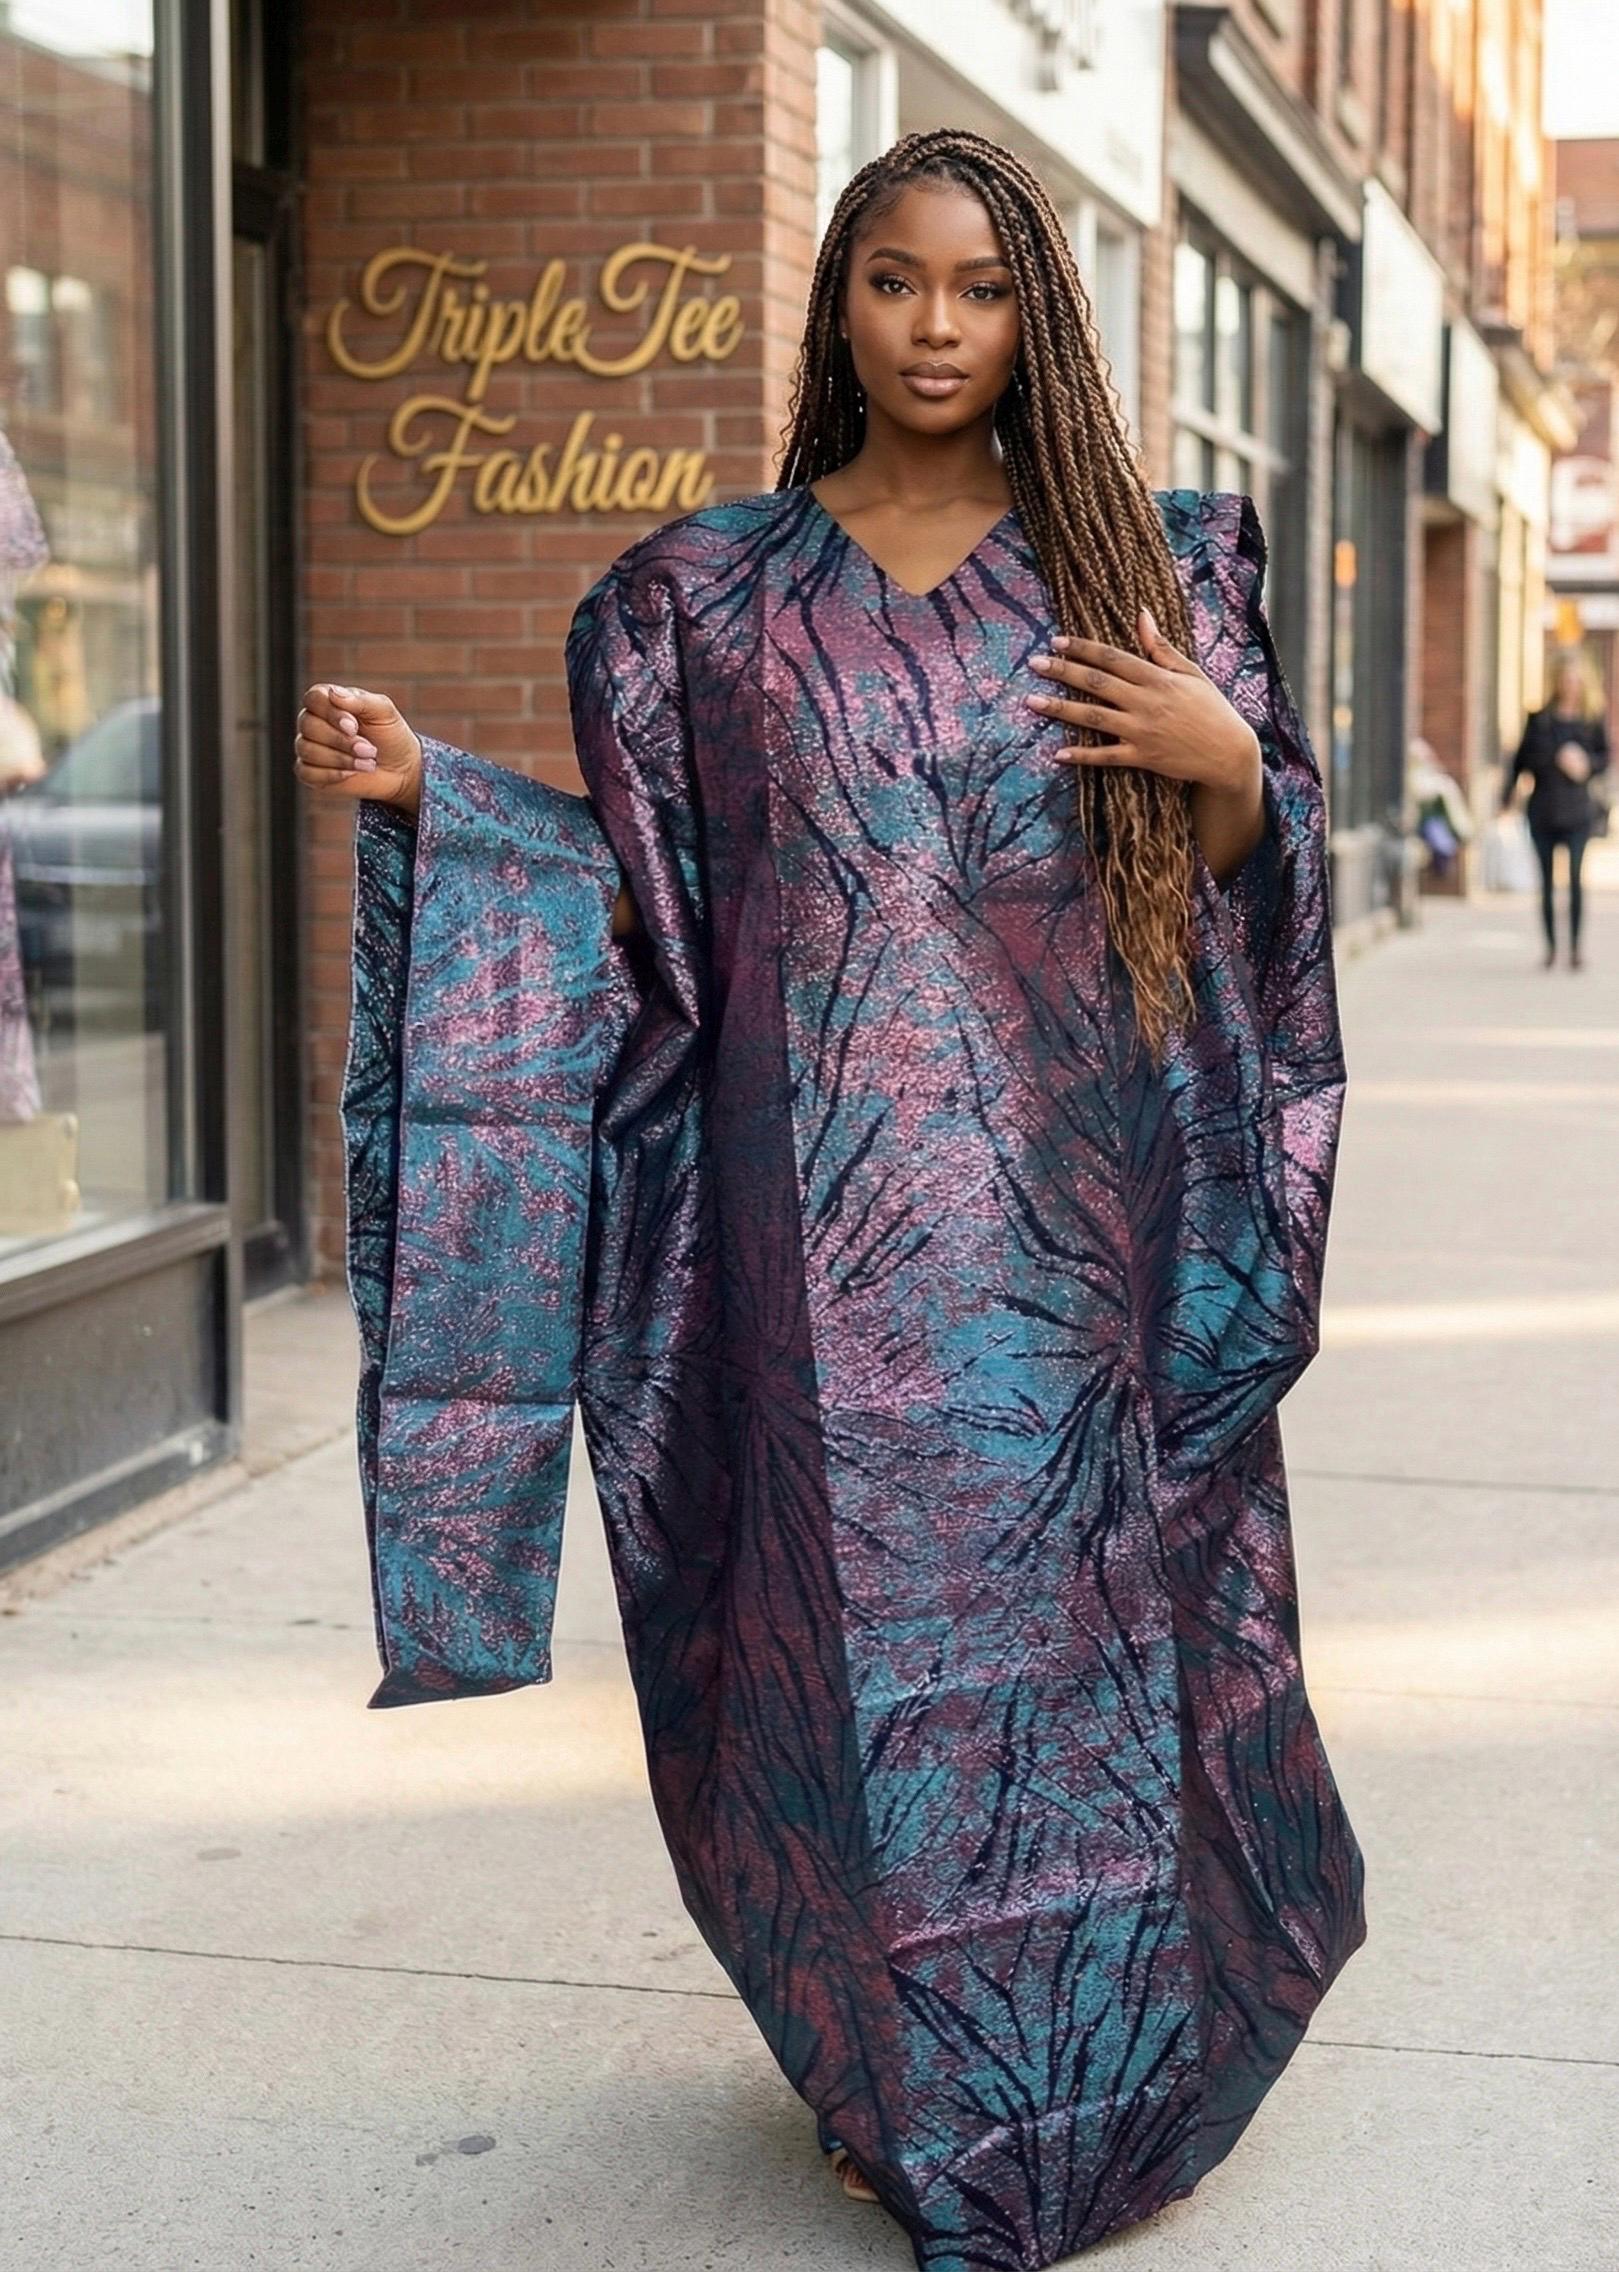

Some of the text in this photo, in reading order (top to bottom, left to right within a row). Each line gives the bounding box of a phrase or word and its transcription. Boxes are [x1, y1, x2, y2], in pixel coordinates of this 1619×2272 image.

[328, 243, 744, 400] Triple Tee
[356, 394, 714, 535] Fashion
